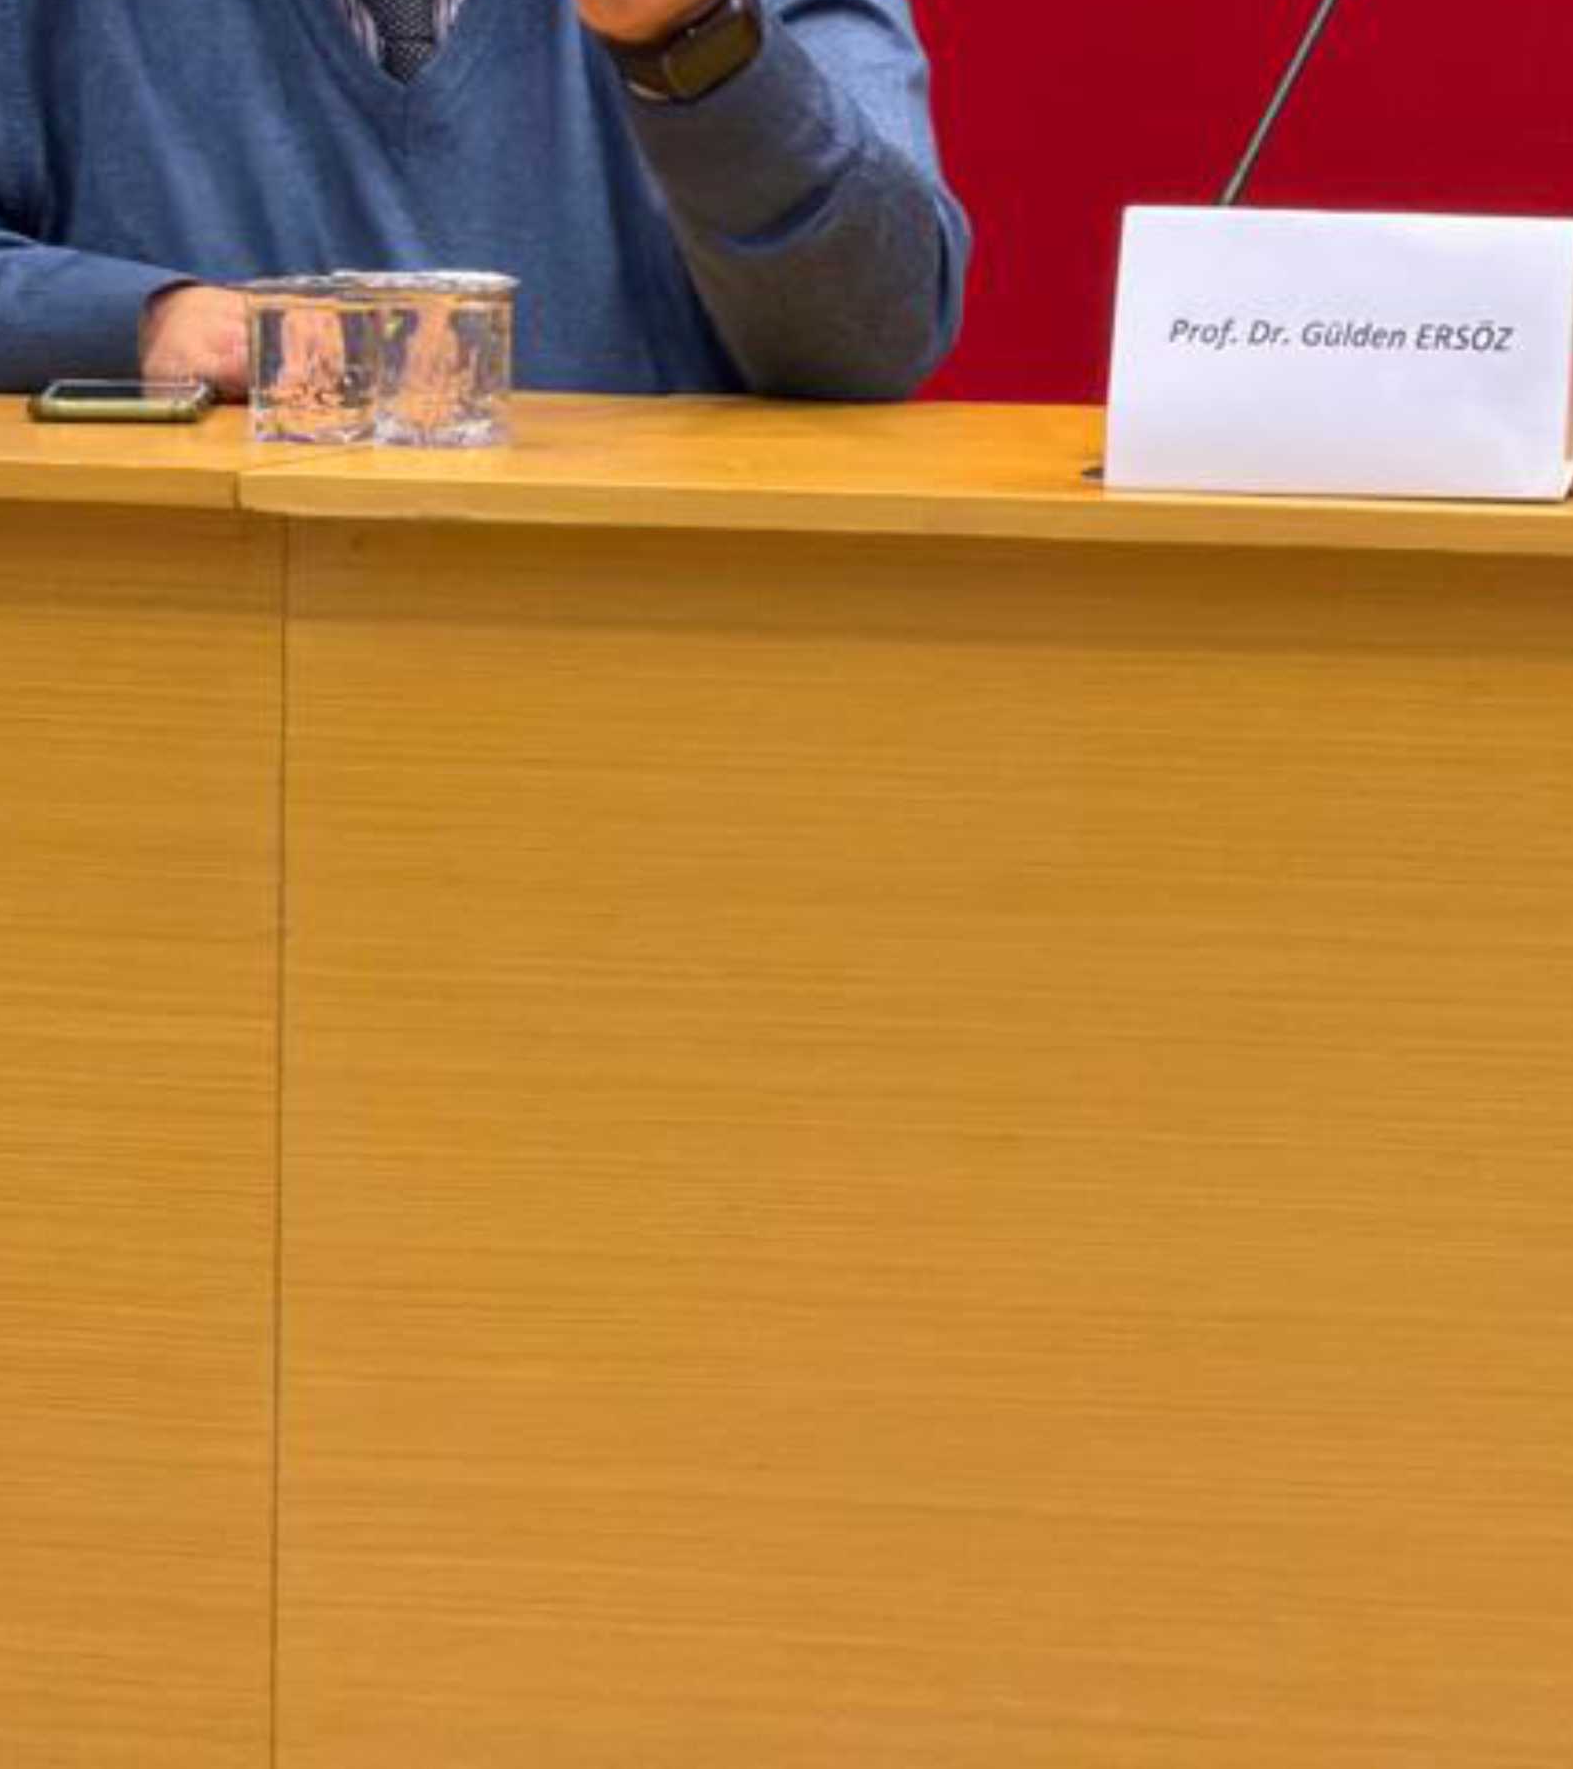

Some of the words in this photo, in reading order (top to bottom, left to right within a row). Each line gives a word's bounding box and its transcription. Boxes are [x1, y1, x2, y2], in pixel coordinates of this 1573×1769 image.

[1169, 318, 1238, 349] Prof.
[1247, 319, 1290, 346] Dr.
[1301, 320, 1407, 350] Gülden
[1415, 319, 1514, 352] ERSÖZ
